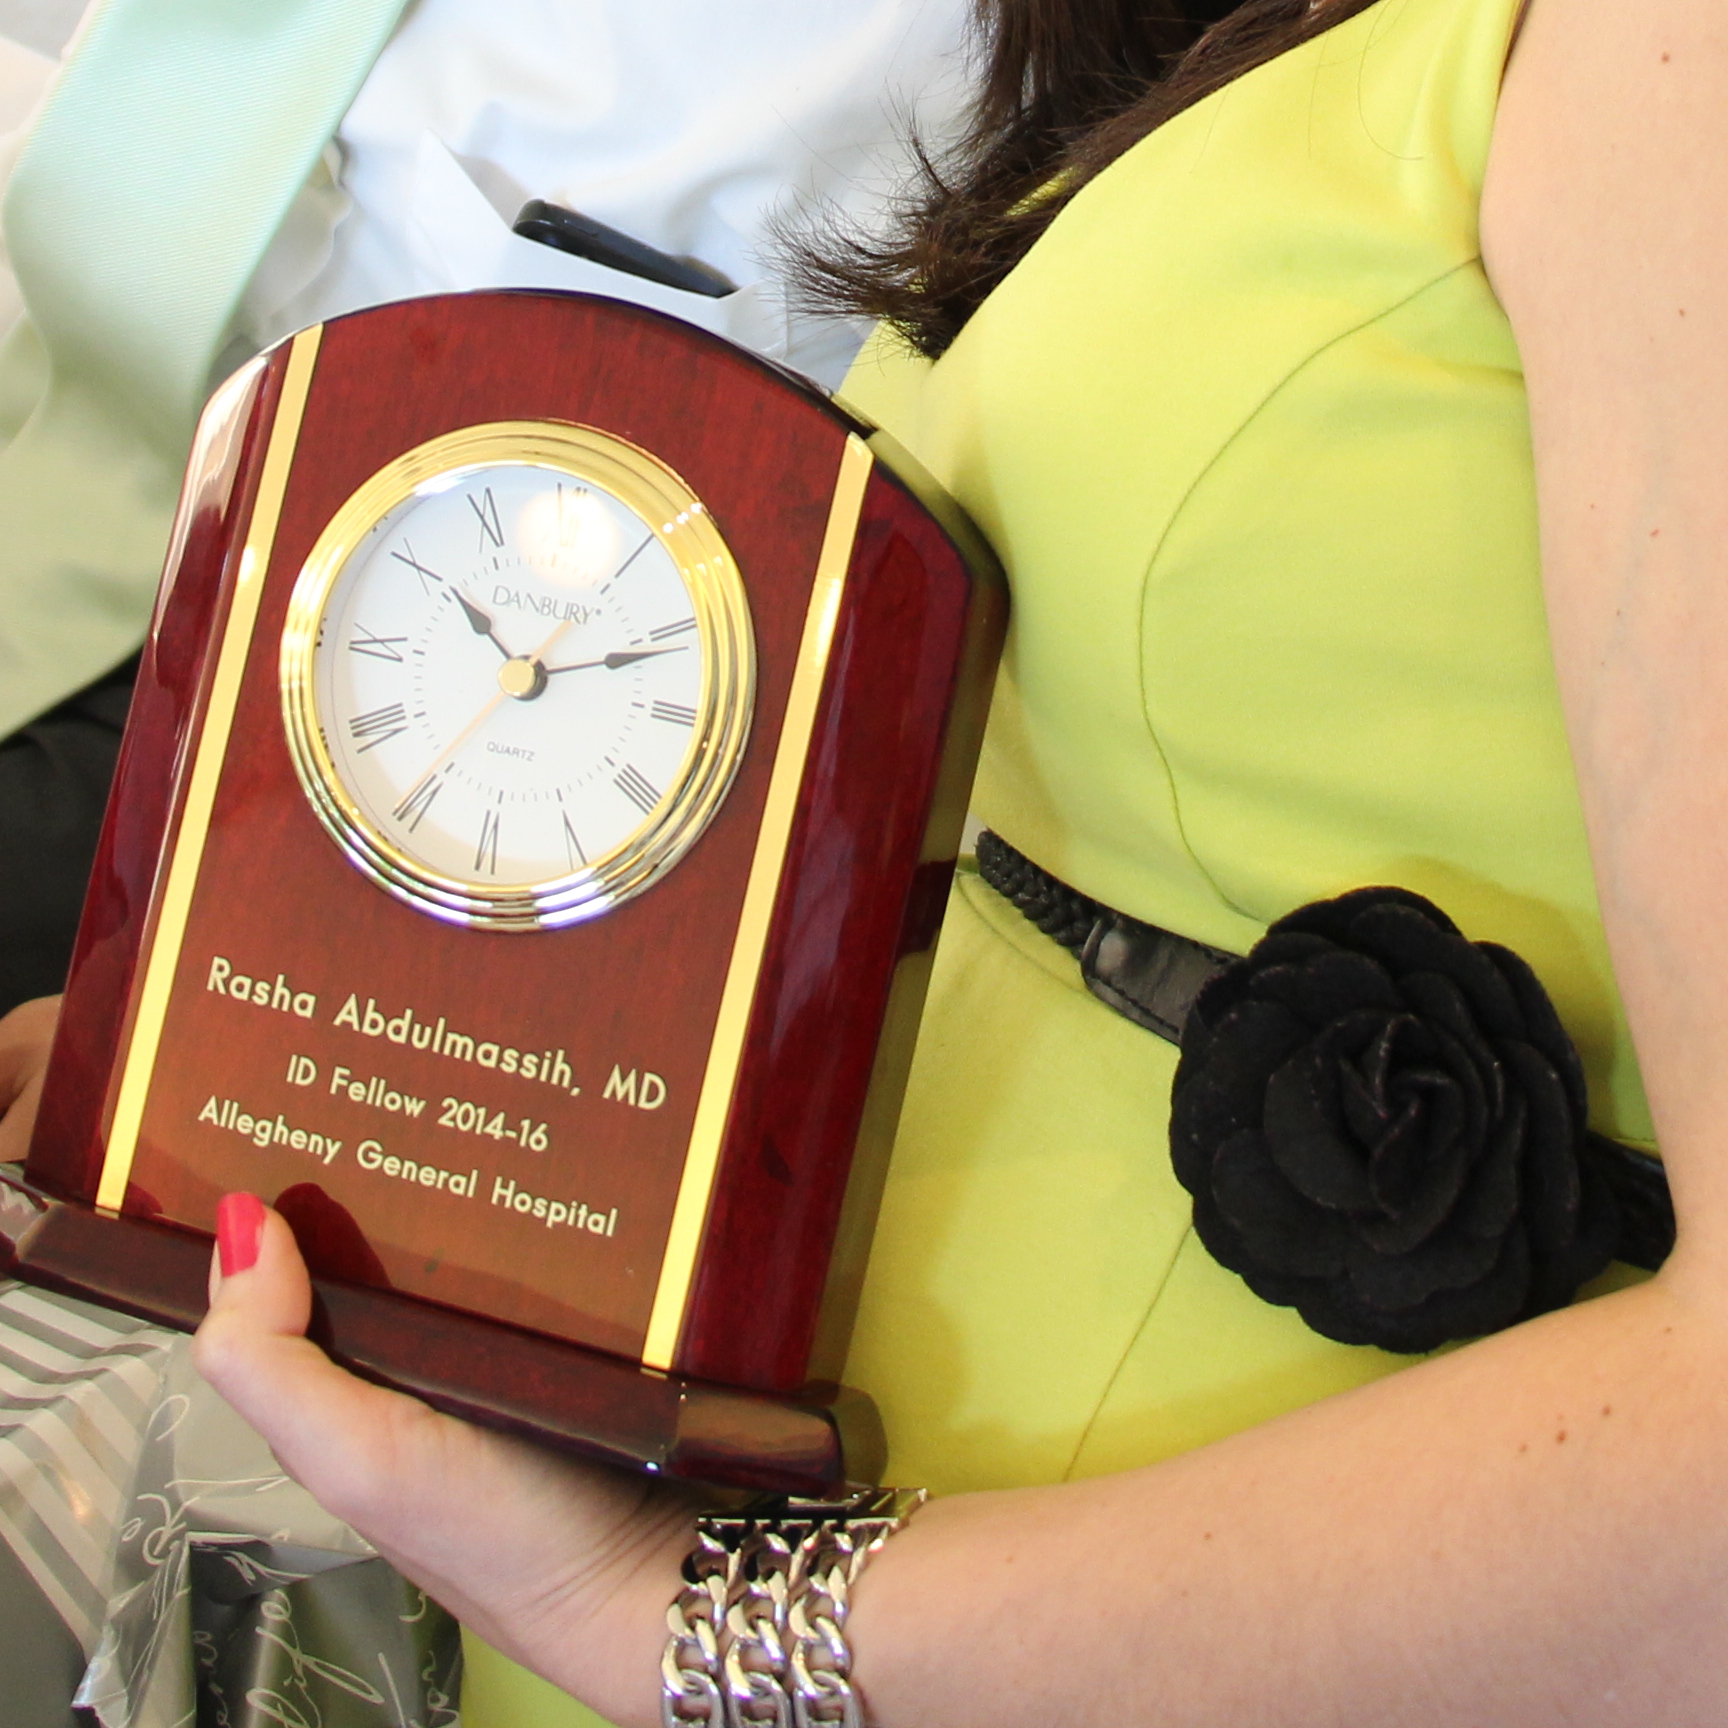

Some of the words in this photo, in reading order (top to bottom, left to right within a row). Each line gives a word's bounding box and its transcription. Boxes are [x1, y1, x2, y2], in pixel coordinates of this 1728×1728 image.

[486, 741, 536, 763] QUARTZ
[207, 956, 317, 1019] Rasha
[332, 992, 582, 1098] Abdulmassih,
[602, 1063, 668, 1111] MD
[286, 1054, 318, 1087] ID
[329, 1066, 426, 1119] Fellow
[437, 1096, 550, 1153] 2014-16
[198, 1094, 343, 1165] Allegheny
[356, 1139, 477, 1198] General
[490, 1177, 619, 1238] Hospital
